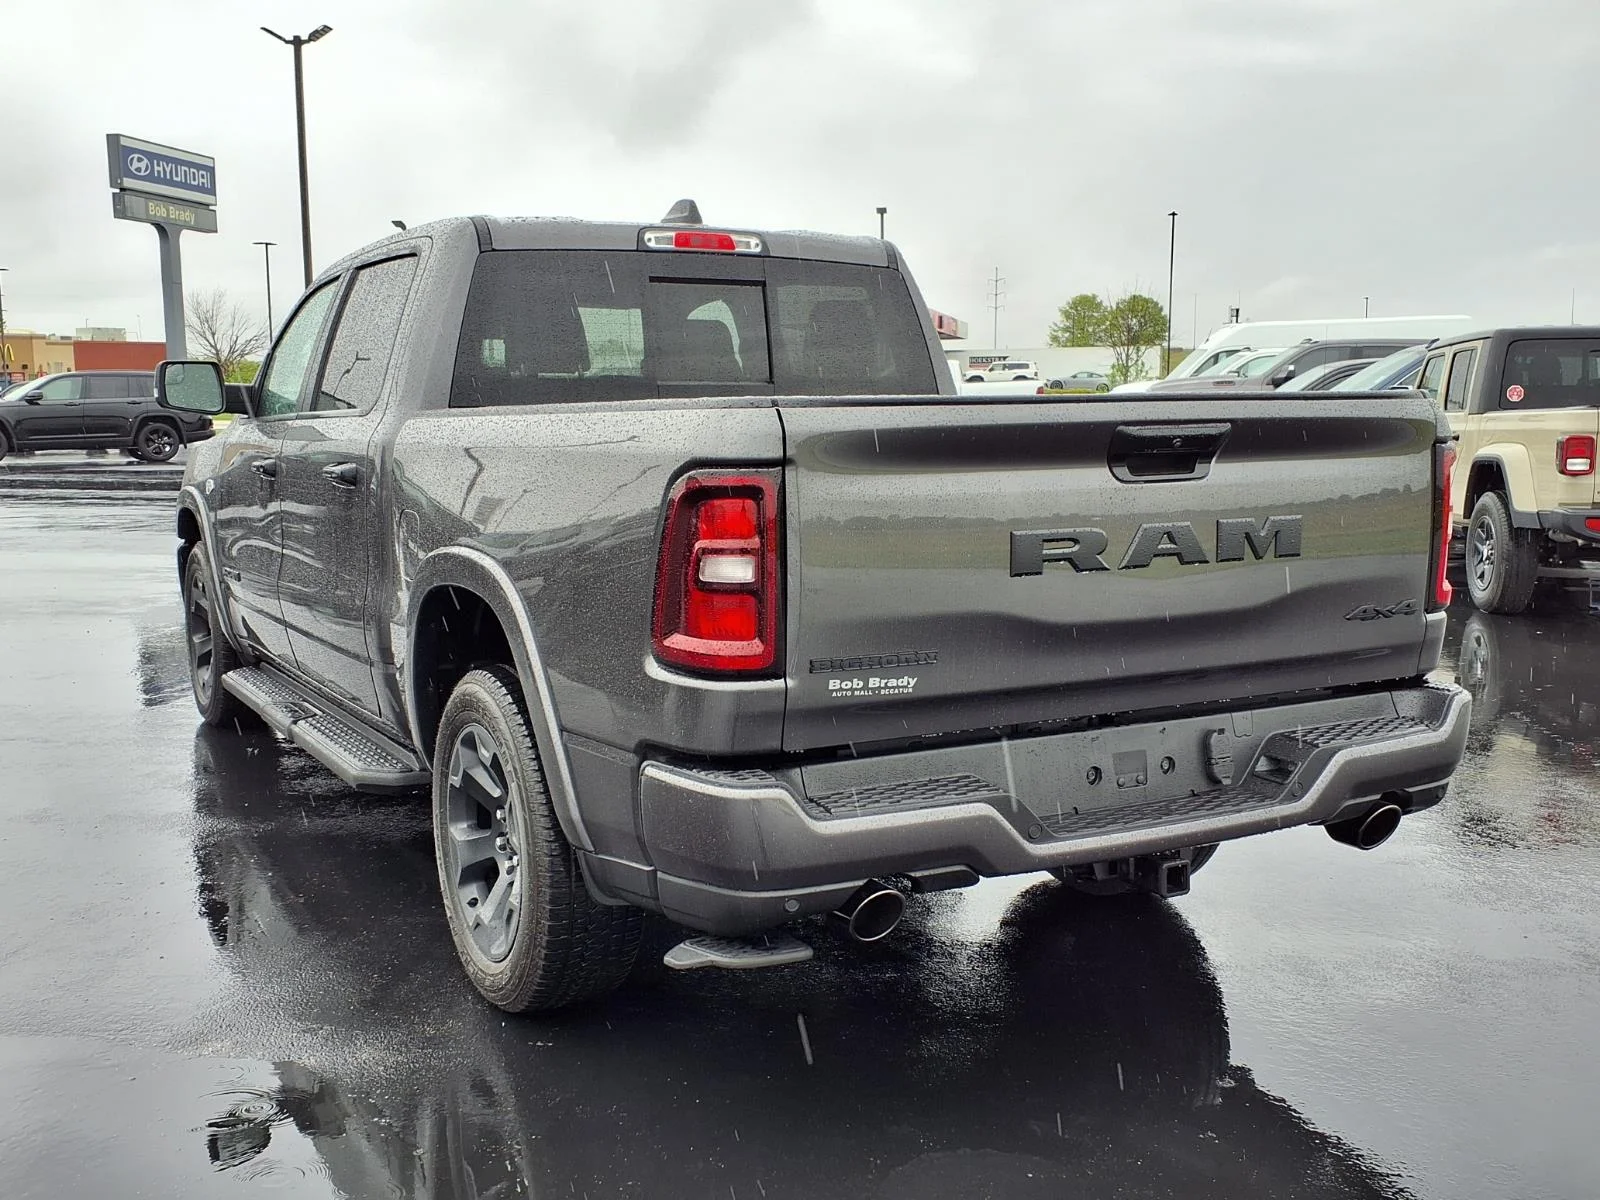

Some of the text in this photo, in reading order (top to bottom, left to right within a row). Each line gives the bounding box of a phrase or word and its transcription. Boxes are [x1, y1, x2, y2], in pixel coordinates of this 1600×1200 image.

[154, 159, 211, 188] HYUNDAI
[148, 202, 195, 224] Bob Brady
[1010, 515, 1303, 577] RAM
[828, 676, 918, 690] Bob Brady
[880, 687, 913, 695] DECATUR
